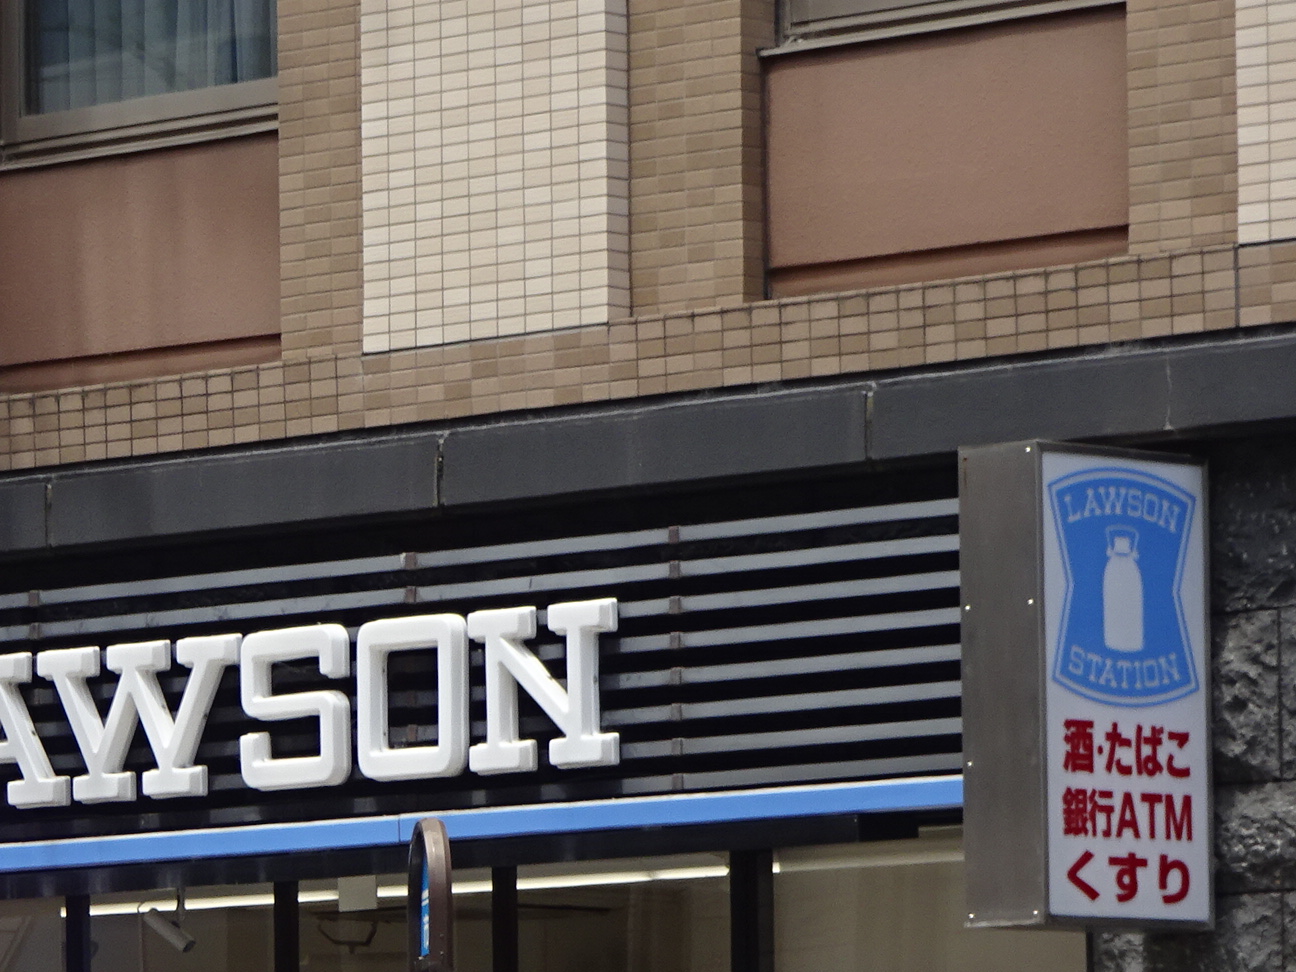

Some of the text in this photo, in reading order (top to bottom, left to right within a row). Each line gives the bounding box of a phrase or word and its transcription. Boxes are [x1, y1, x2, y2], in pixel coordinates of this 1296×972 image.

[1064, 486, 1182, 534] LAWSON
[1068, 645, 1183, 690] STATION
[1063, 787, 1193, 842] 銀行ATM
[1067, 850, 1190, 904] くすり
